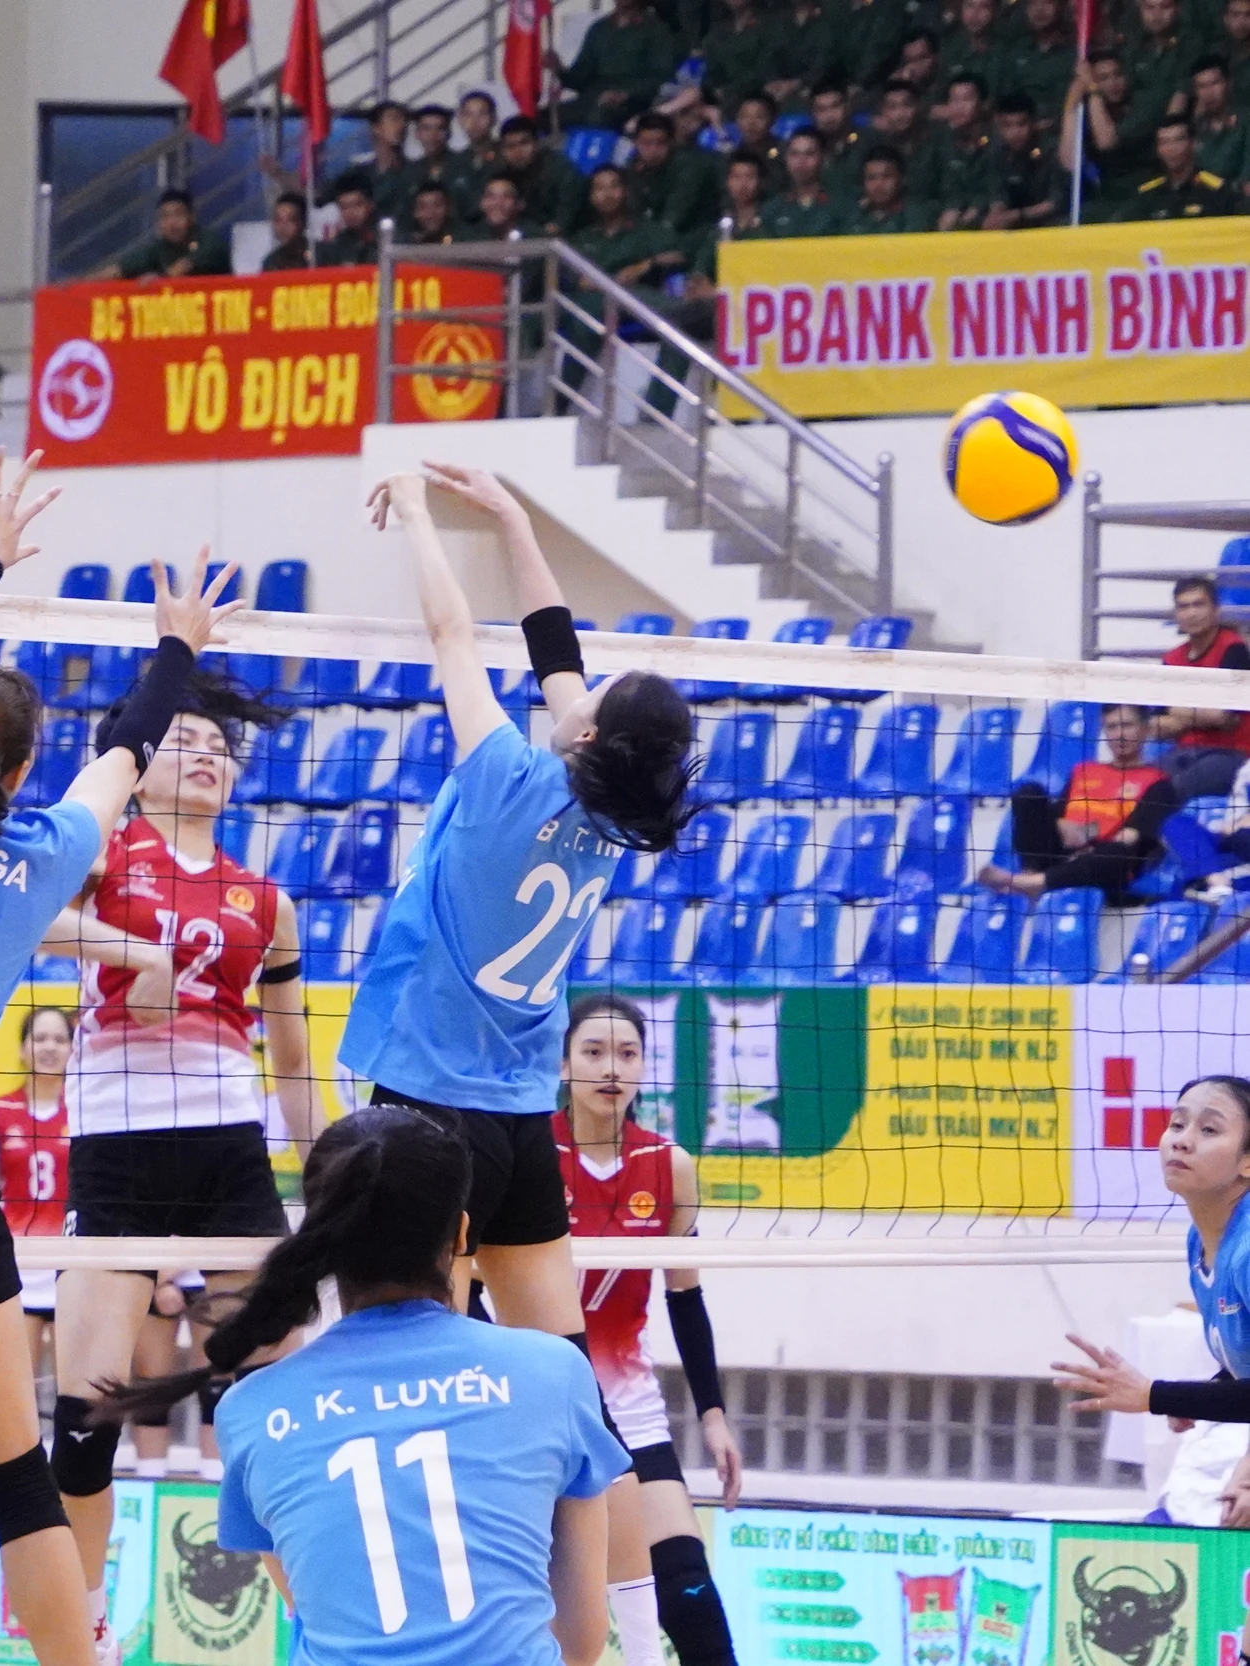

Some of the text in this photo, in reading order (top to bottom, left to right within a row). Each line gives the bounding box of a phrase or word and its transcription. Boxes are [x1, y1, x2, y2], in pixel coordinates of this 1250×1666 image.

[91, 296, 125, 341] BC
[128, 287, 207, 339] THÔNG
[212, 289, 252, 334] TIN
[717, 249, 1249, 369] LPBANK NINH BÌNH
[165, 346, 361, 446] VÔ ĐỊCH
[154, 907, 225, 1001] 12
[474, 862, 607, 1006] 22
[27, 1150, 57, 1202] 8
[266, 1364, 511, 1441] Q. K. LUYẾN
[326, 1429, 476, 1635] 11
